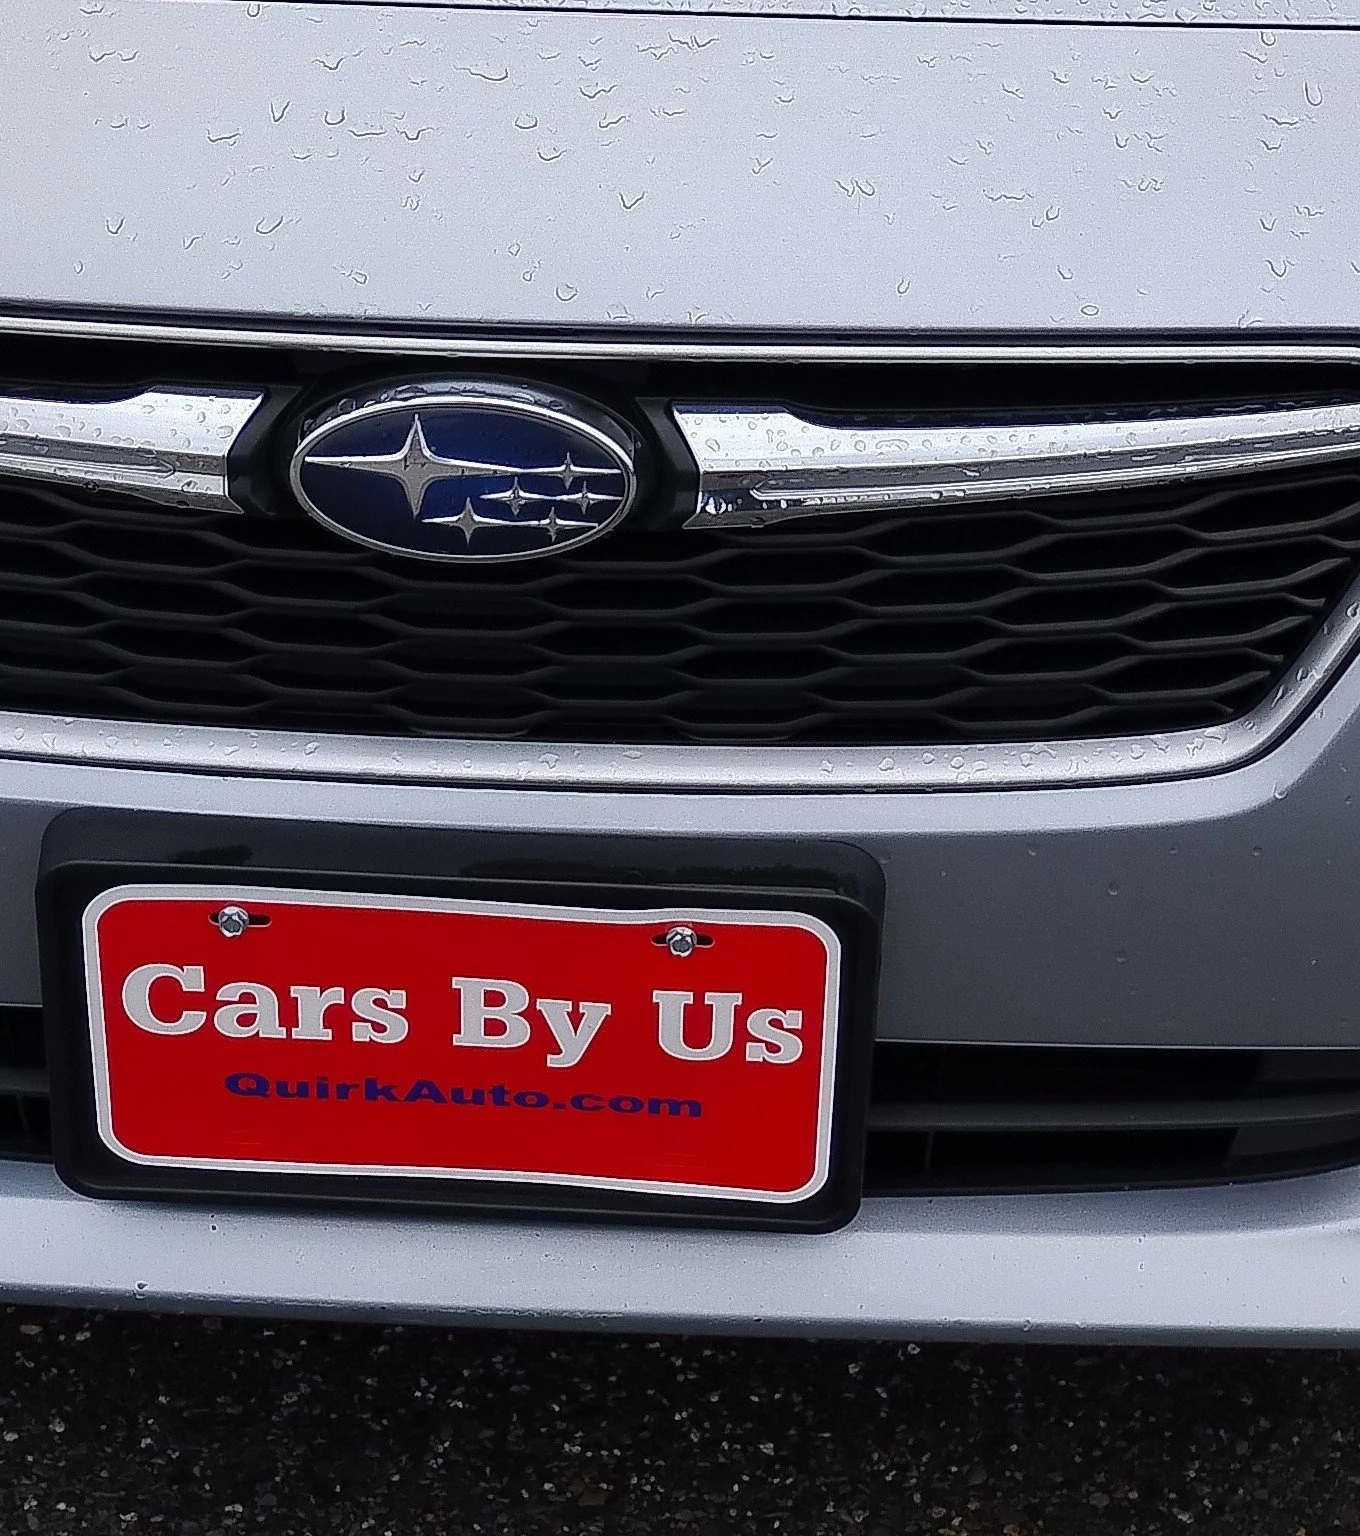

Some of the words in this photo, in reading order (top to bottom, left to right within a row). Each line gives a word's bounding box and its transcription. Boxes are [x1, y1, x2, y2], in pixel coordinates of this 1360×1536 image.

[121, 963, 408, 1044] Cars
[452, 977, 611, 1068] By
[652, 990, 805, 1064] Us
[224, 1073, 702, 1118] QuirkAuto.com
